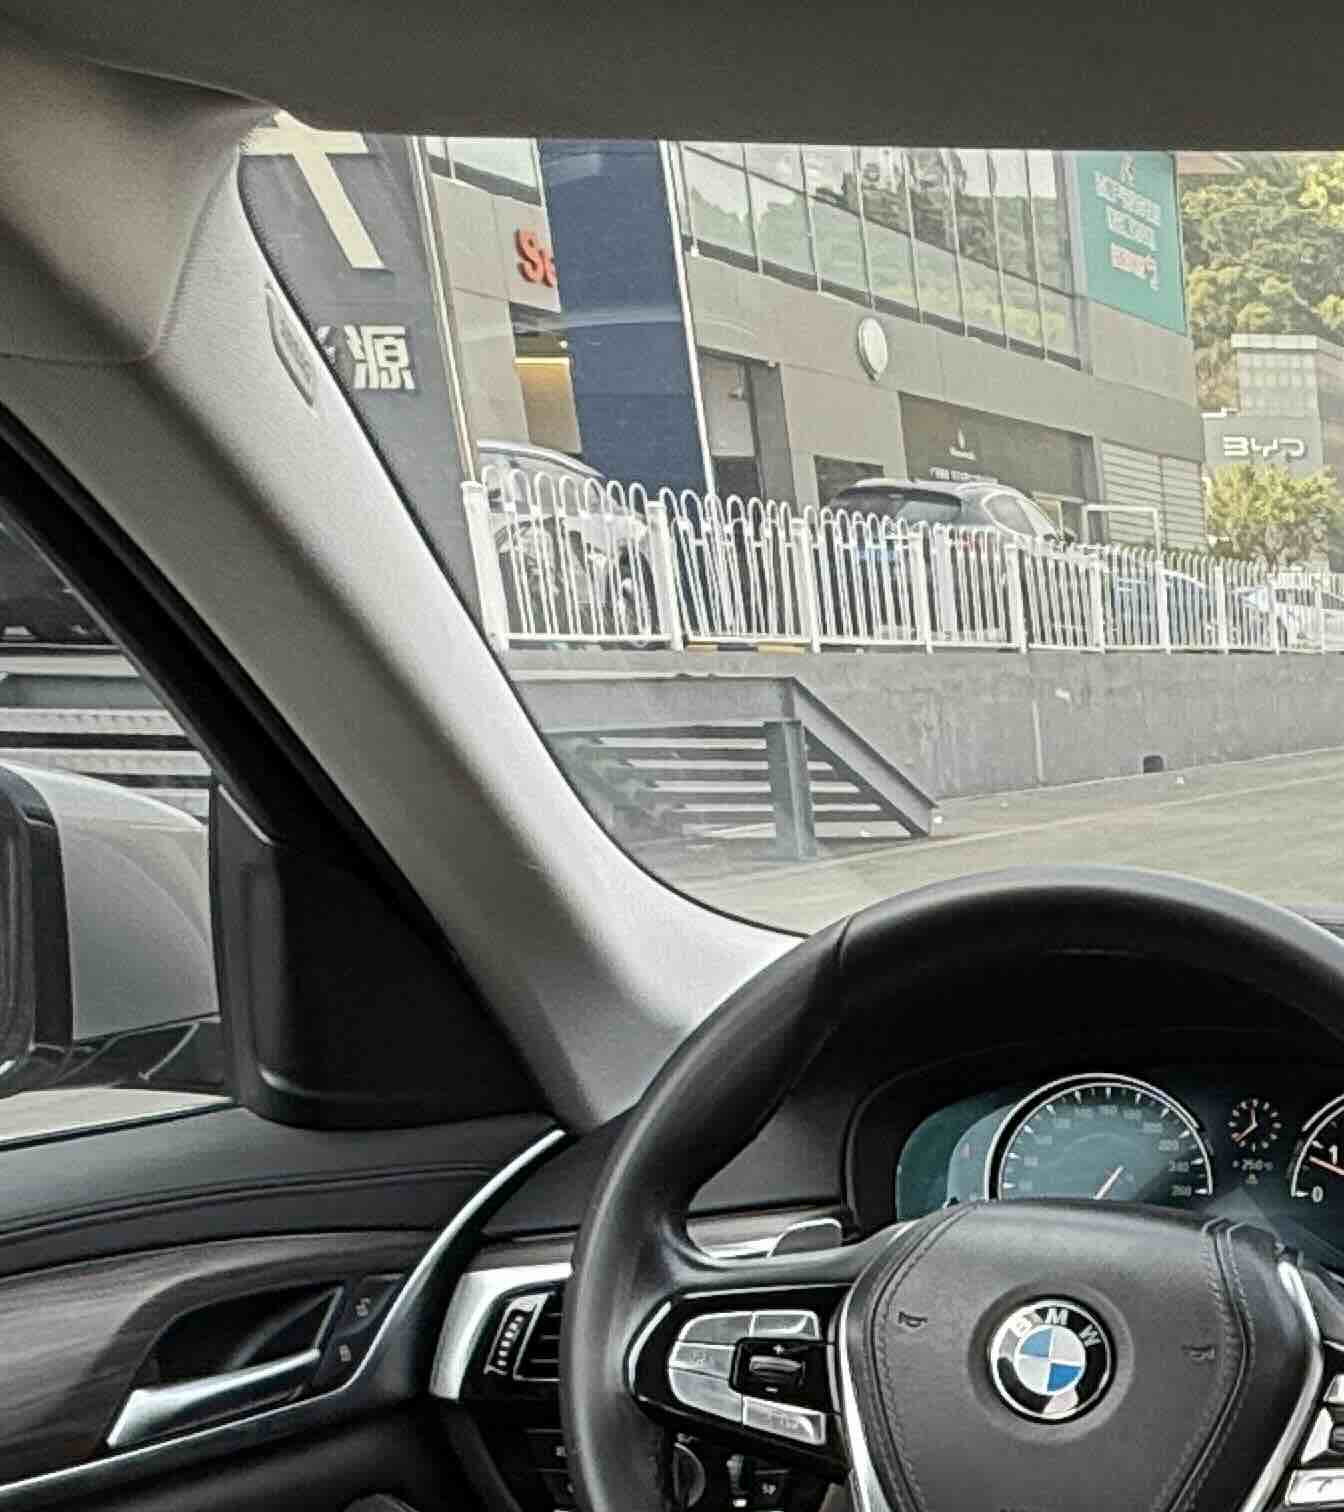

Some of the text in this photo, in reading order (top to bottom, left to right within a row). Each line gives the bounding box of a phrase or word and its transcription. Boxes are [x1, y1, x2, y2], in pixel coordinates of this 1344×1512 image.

[1222, 435, 1305, 458] BYD
[1327, 1144, 1339, 1165] 1
[1311, 1185, 1324, 1203] 0
